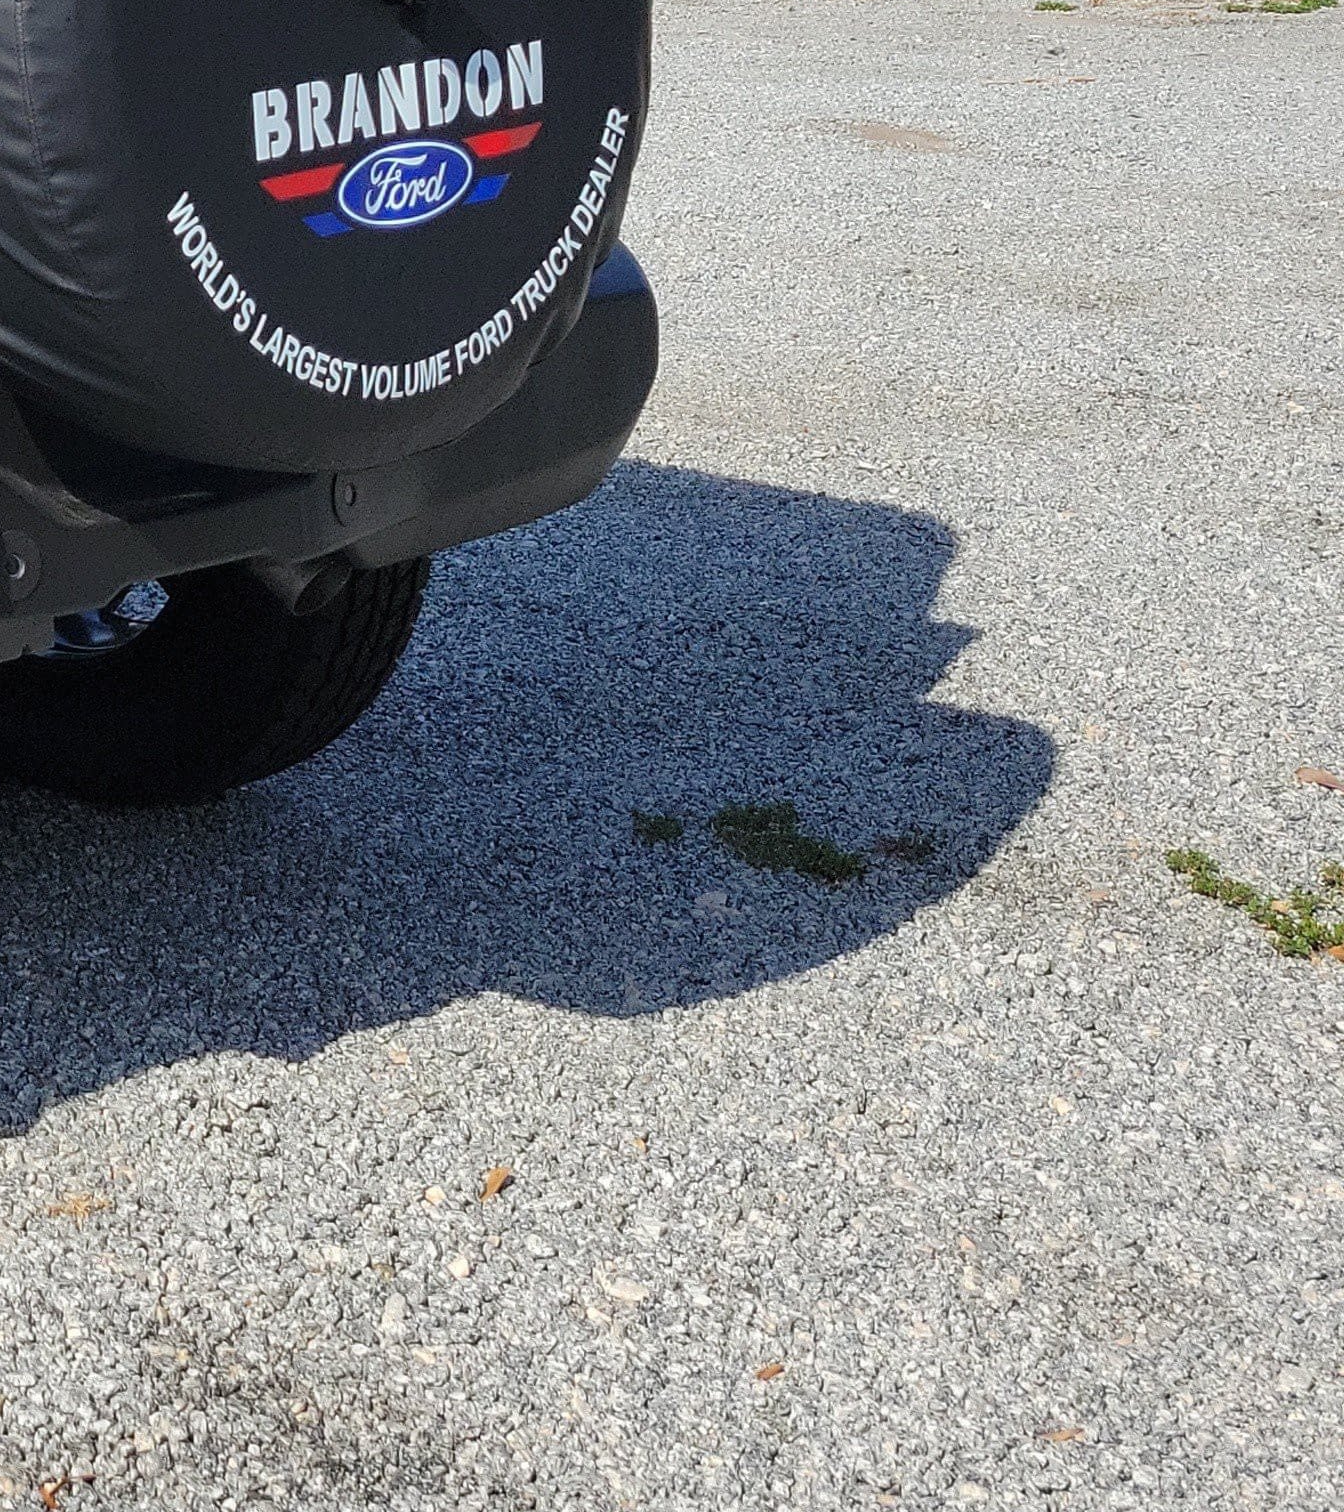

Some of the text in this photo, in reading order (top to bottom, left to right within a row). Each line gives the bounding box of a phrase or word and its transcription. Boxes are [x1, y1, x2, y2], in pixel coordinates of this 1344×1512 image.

[252, 40, 543, 161] BRANDON
[365, 153, 447, 214] Ford
[166, 107, 631, 401] WORLD'S LARGEST VOLUME FORD TRUCK DEALER
